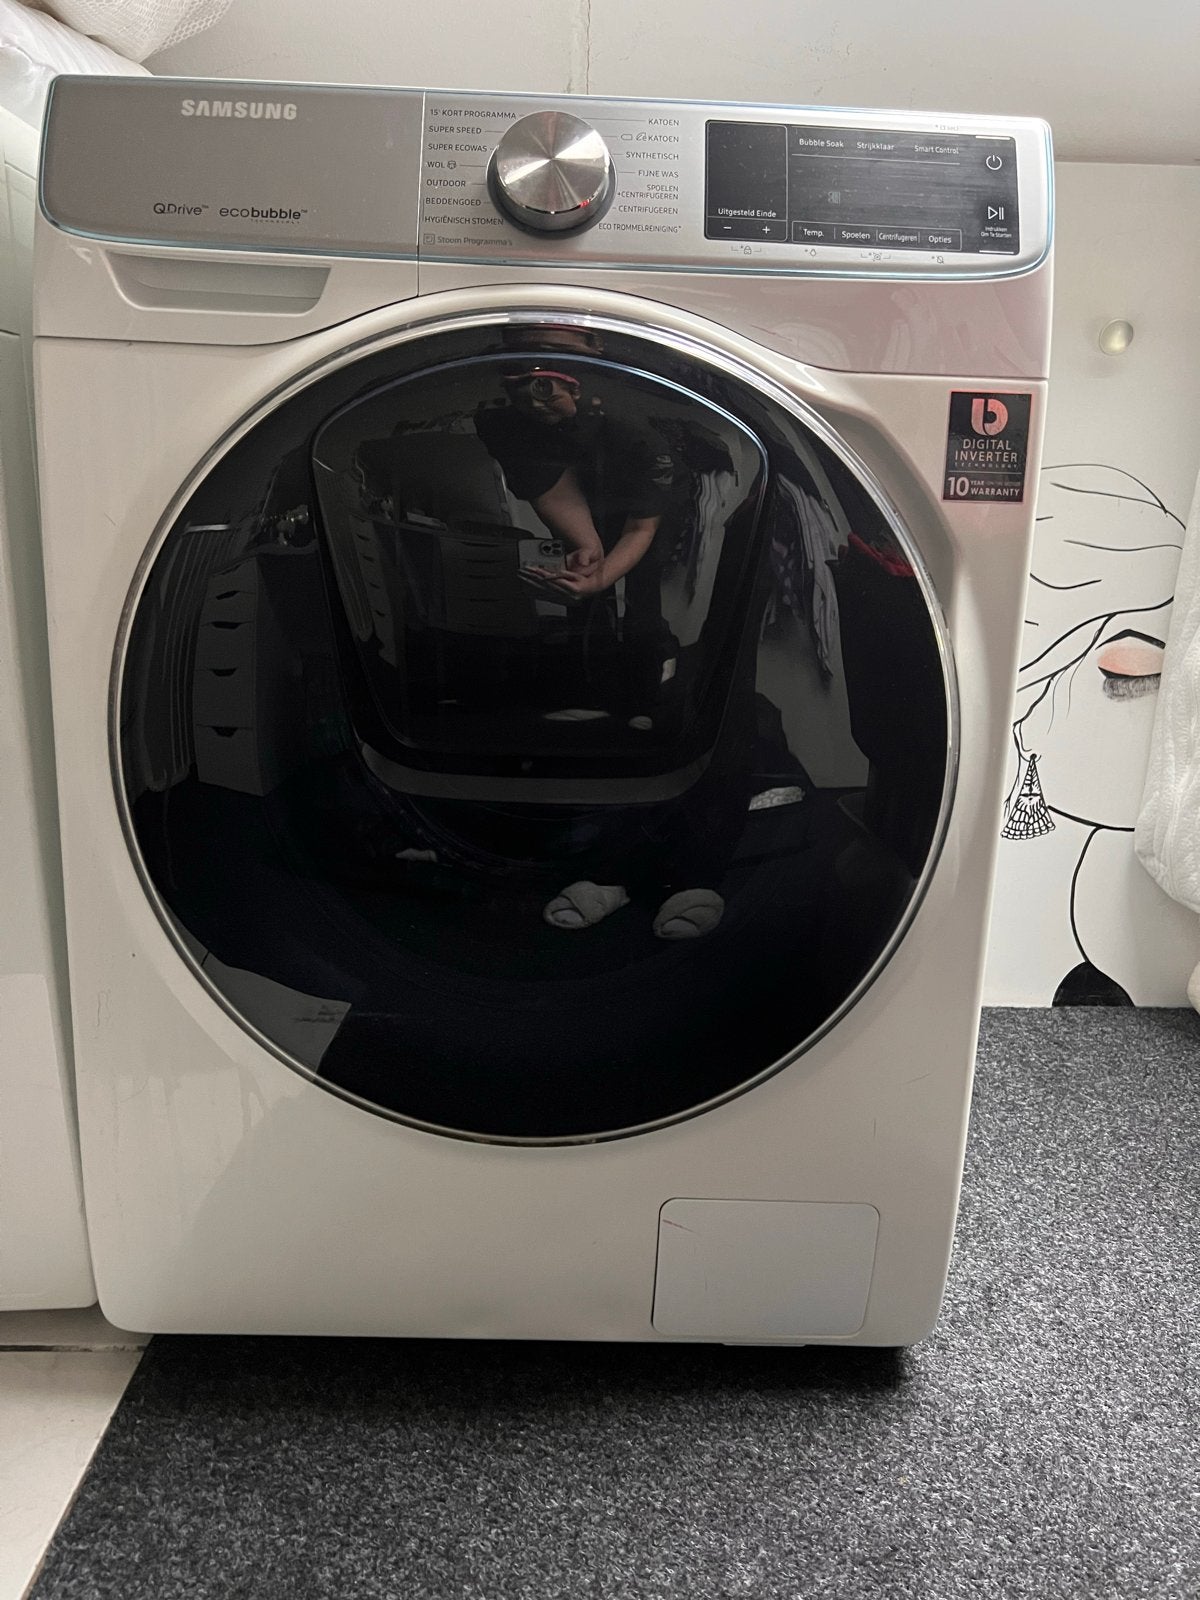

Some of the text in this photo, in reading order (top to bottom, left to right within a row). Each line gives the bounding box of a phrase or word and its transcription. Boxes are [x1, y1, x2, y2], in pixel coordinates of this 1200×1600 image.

[181, 99, 297, 120] SAMSUNG
[442, 109, 462, 117] KORT
[464, 111, 516, 119] PROGRAMMA
[648, 118, 679, 126] KATOEN
[428, 125, 482, 135] SUPER SPEED
[648, 135, 679, 143] KATOEN
[799, 138, 844, 148] Bubble Soak
[427, 143, 487, 152] SUPER ECOWAS
[856, 141, 895, 151] Strijkklaar
[914, 144, 959, 154] Smart Control
[625, 151, 679, 160] SYNTHETISCH
[638, 169, 679, 178] FIJNE WAS
[426, 179, 466, 187] OUTDOOR
[646, 184, 679, 192] SPOELEN
[425, 197, 481, 206] BEDDENGOED
[618, 205, 679, 214] CENTRIFUGEREN
[718, 208, 755, 216] Uitgesteld
[471, 217, 504, 225] STOMEN
[803, 228, 824, 237] Temp.
[842, 230, 870, 239] Spoelen
[879, 232, 917, 242] Centrifugeren
[437, 236, 462, 244] Stoom
[928, 235, 951, 244] Opties
[963, 439, 1012, 450] DIGITAL
[955, 450, 1018, 463] INVERTER
[947, 476, 970, 496] 10
[970, 487, 1020, 496] WARRANTY
